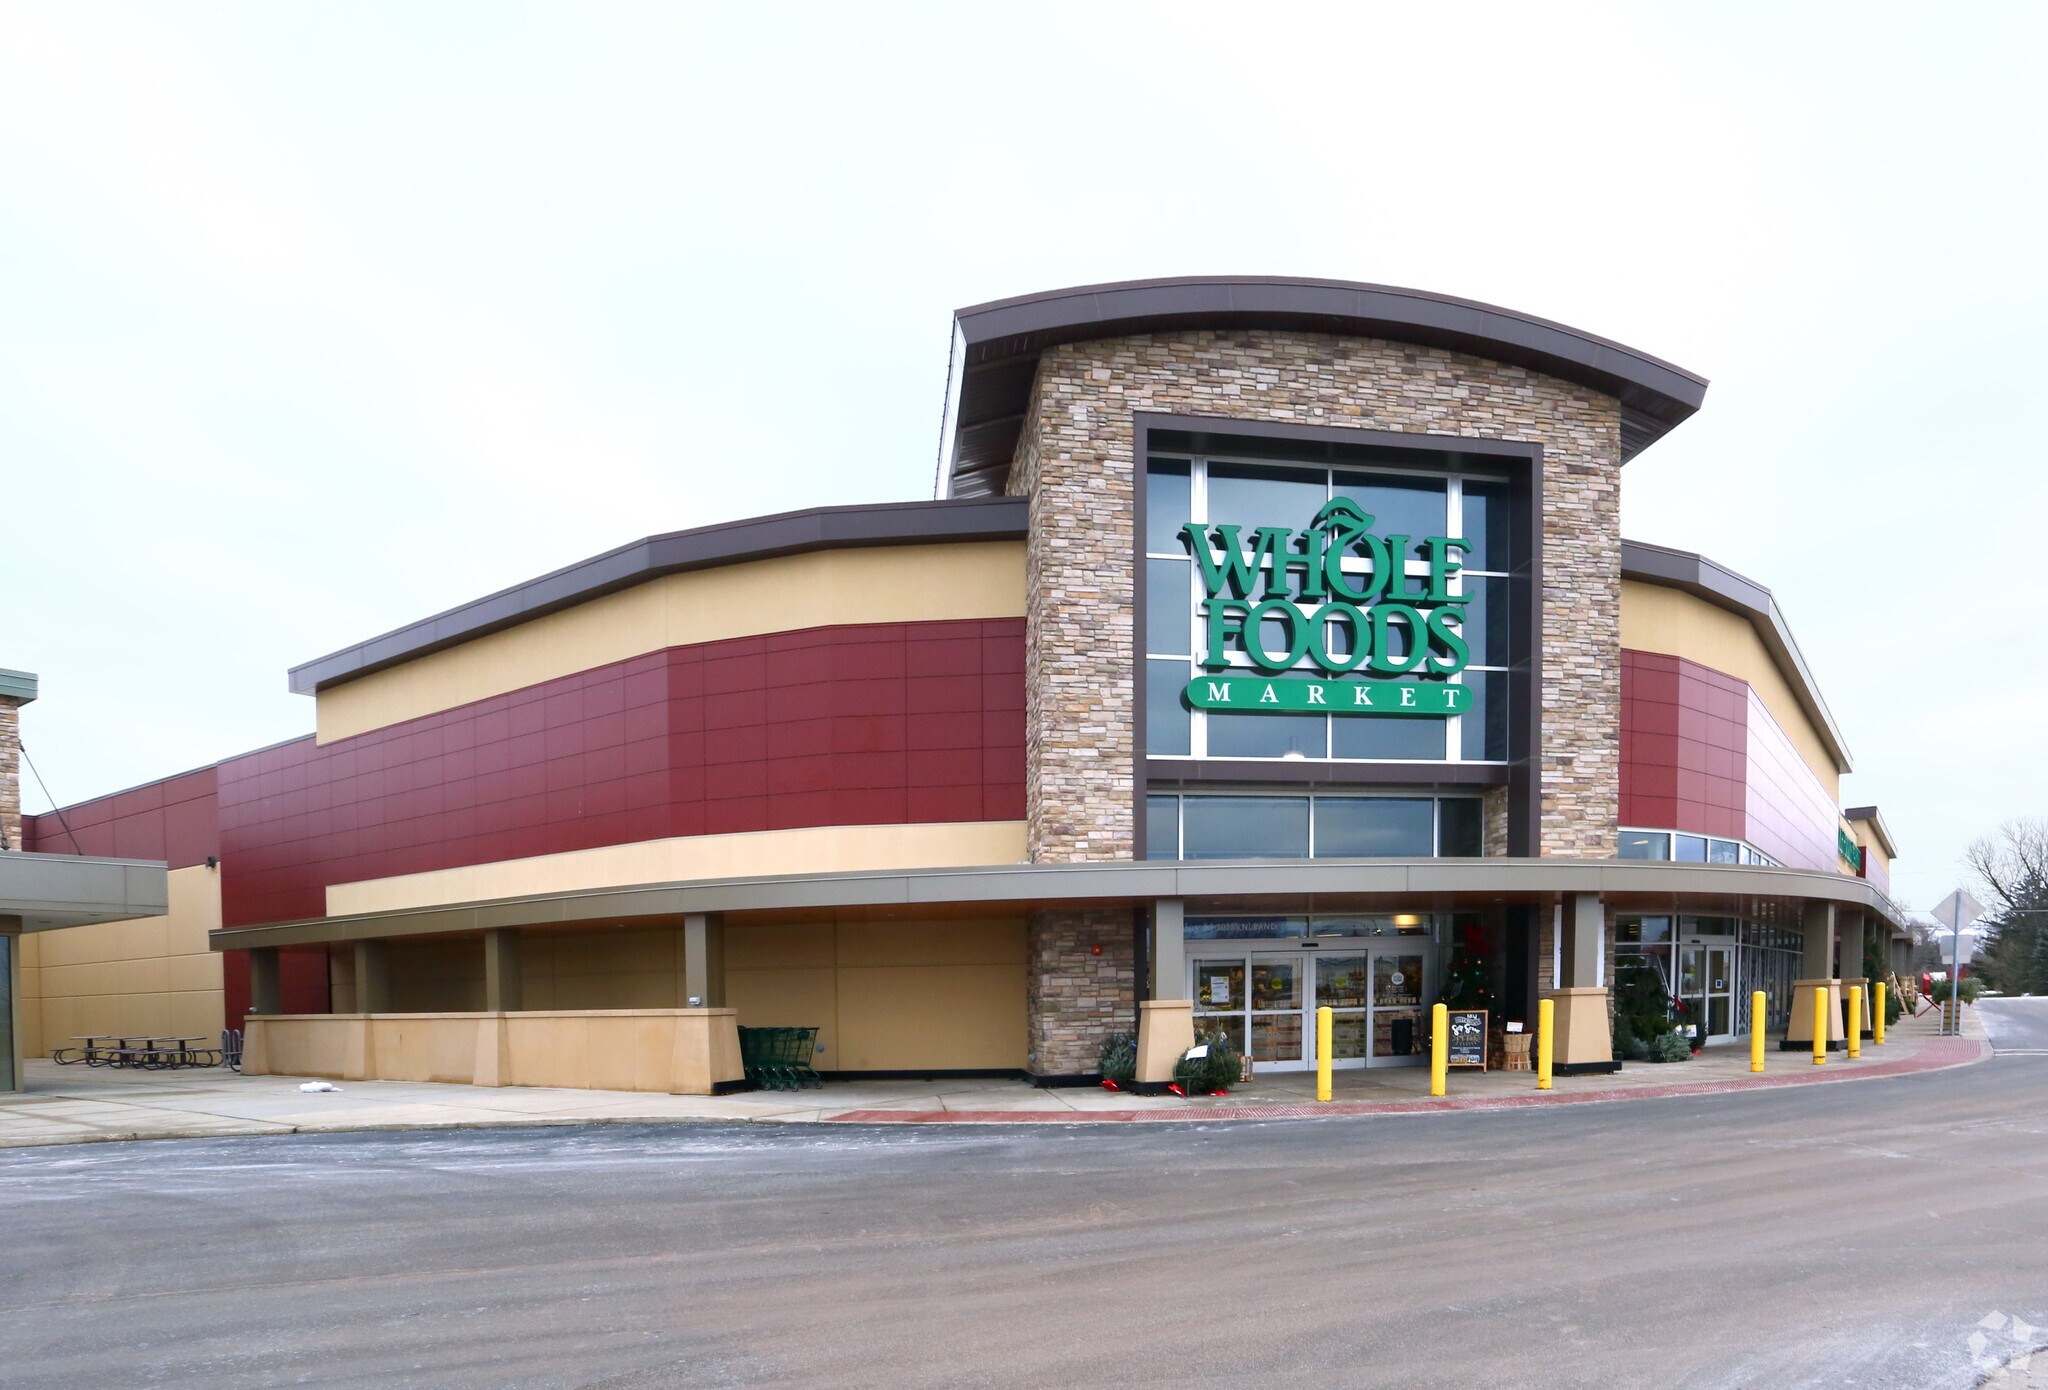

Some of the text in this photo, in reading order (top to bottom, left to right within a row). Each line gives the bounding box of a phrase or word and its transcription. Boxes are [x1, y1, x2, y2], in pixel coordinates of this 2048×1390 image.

[1183, 498, 1475, 604] WHOLE
[1202, 598, 1470, 675] FOODS
[1207, 682, 1460, 708] MARKET
